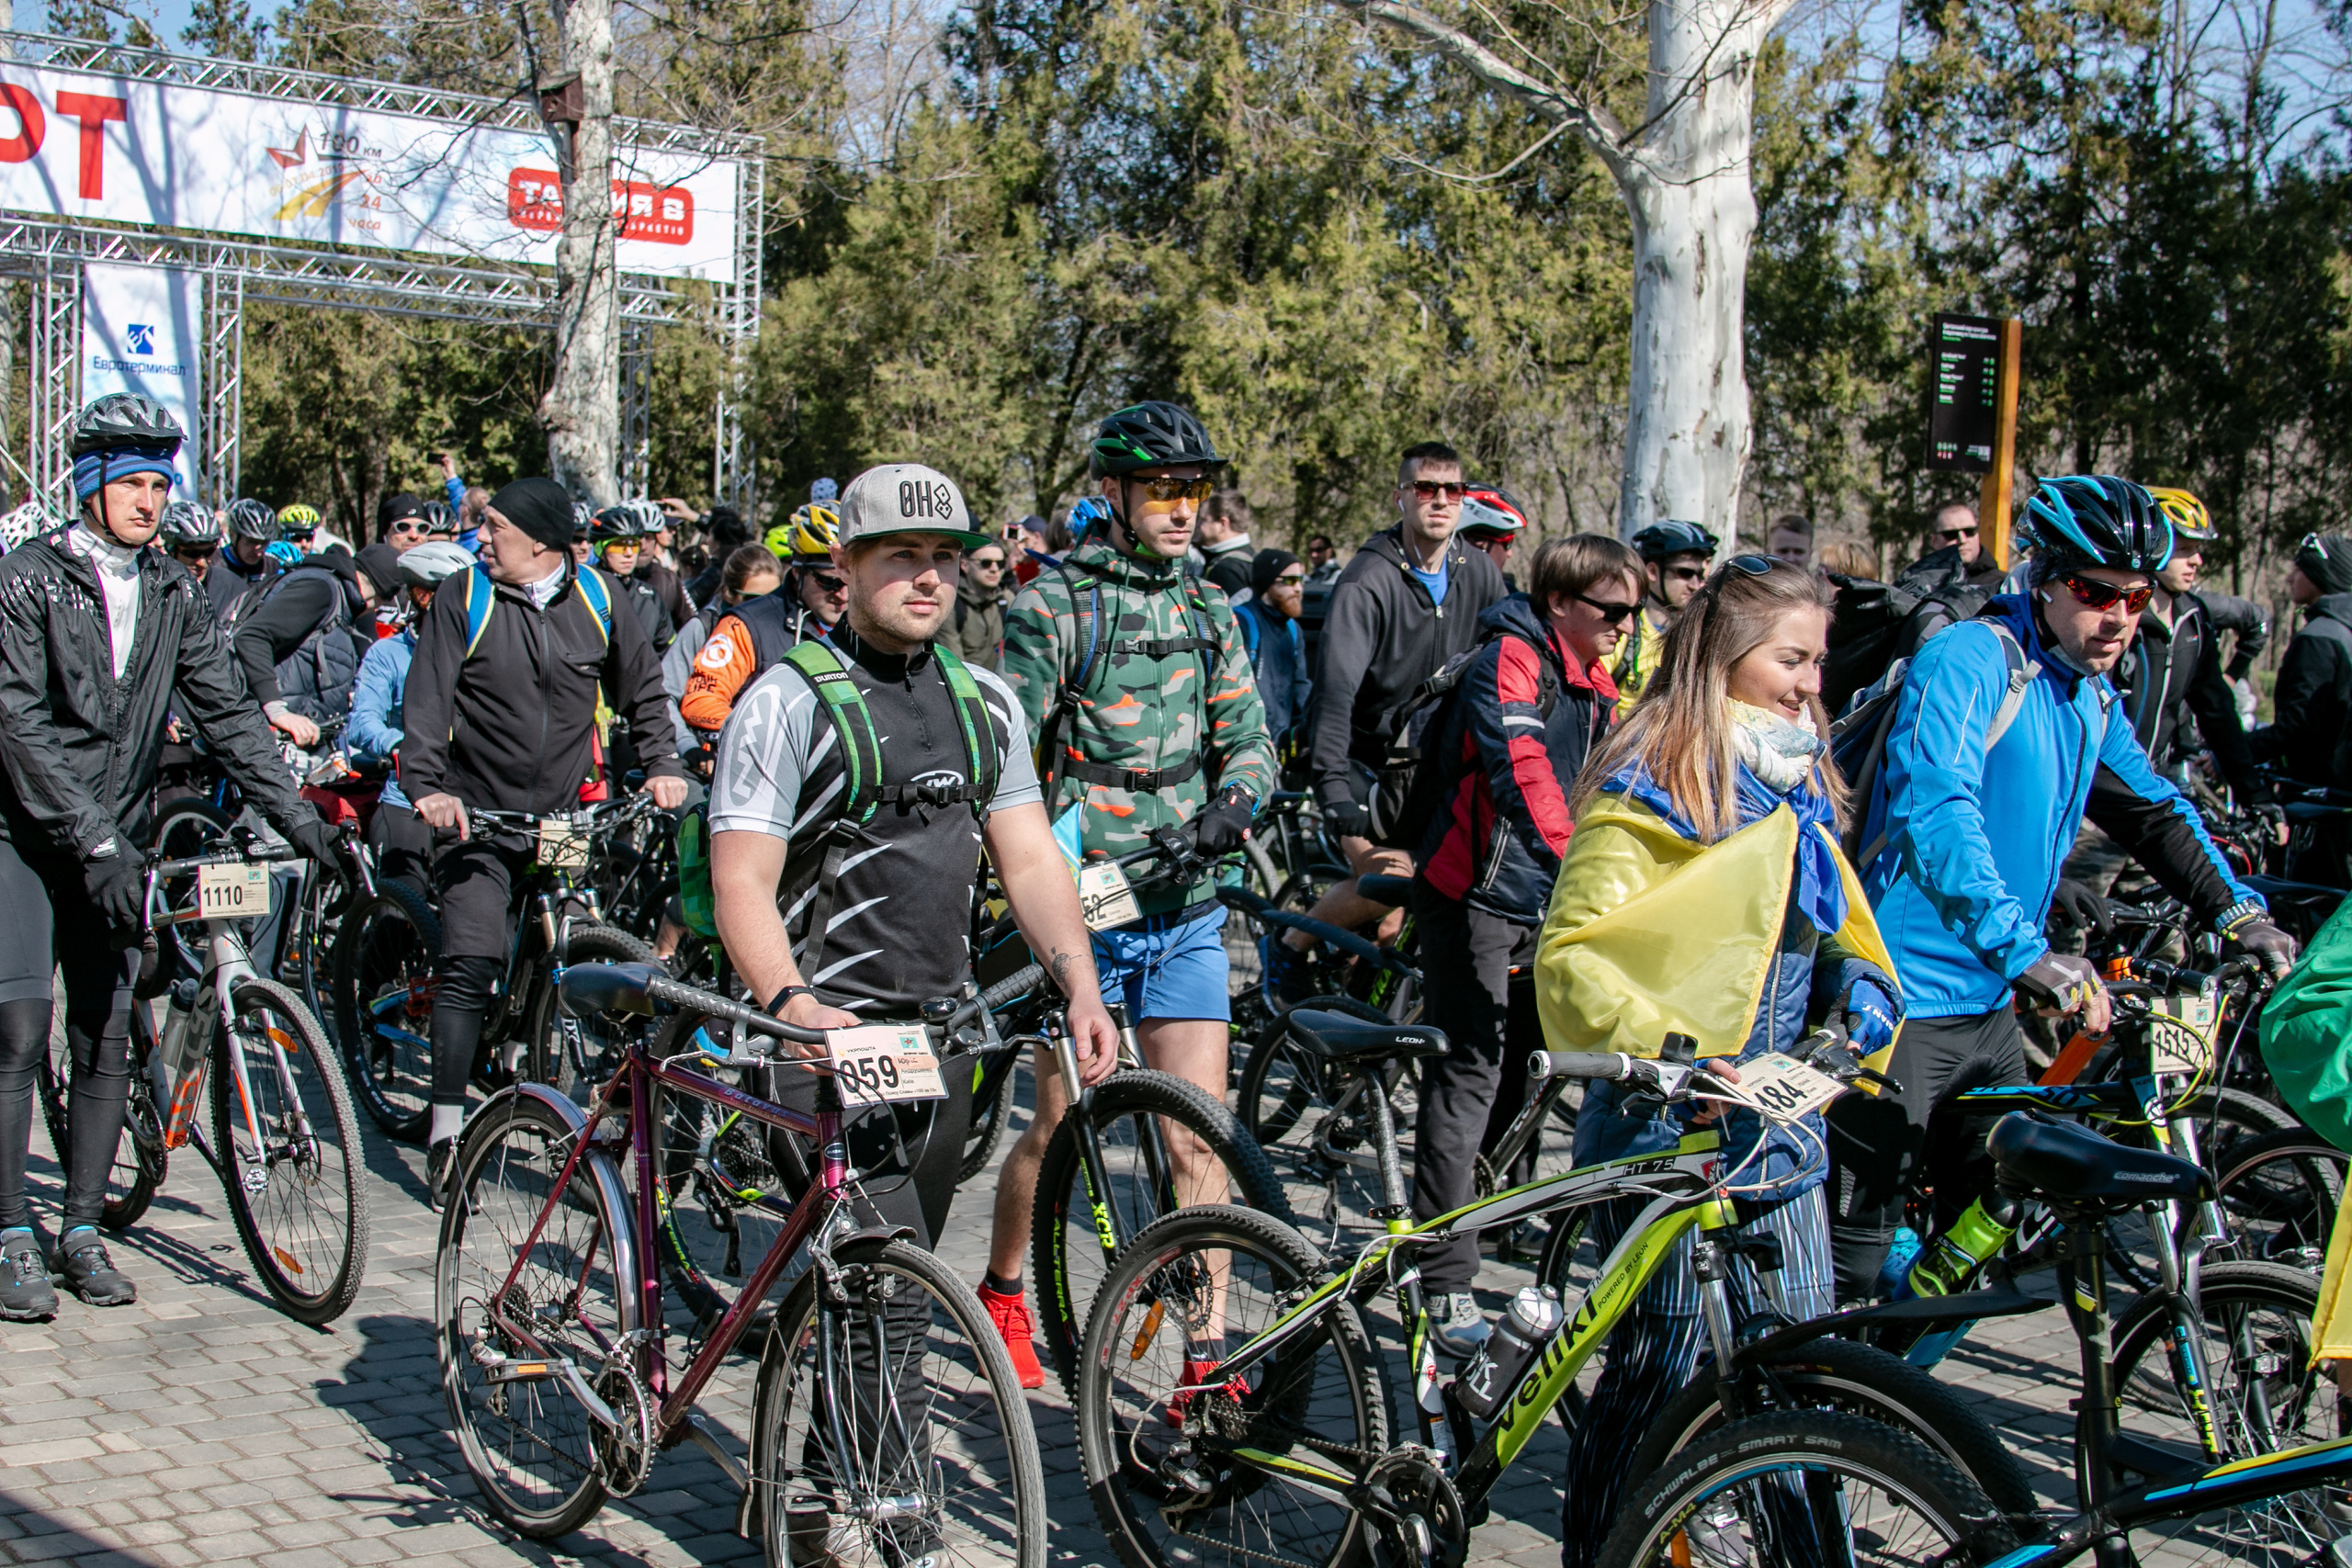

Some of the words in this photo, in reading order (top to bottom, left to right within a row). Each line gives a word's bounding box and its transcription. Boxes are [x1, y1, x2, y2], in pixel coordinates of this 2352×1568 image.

[321, 132, 359, 154] 100
[359, 194, 381, 210] 24
[348, 218, 381, 230] часа
[94, 355, 186, 376] Евротерминал
[814, 671, 850, 683] BURTON
[203, 885, 243, 908] 1110
[846, 1045, 876, 1054] УКРПОШТА
[1395, 1036, 1423, 1044] LEON
[2155, 1029, 2189, 1058] 1515
[839, 1055, 899, 1094] 059
[722, 1087, 789, 1118] Batavus
[1623, 1161, 1647, 1176] HT
[1653, 1158, 1674, 1172] 75
[2113, 1170, 2175, 1184] comanche
[1091, 1201, 1115, 1249] XCR
[1053, 1216, 1069, 1323] ALLTERRA
[1597, 1272, 1626, 1310] POWERED
[1623, 1260, 1634, 1274] BY
[1632, 1242, 1650, 1264] LEON
[1645, 1453, 1720, 1519] SCHWALBE
[1738, 1435, 1798, 1453] SMART
[1804, 1436, 1842, 1450] SAM
